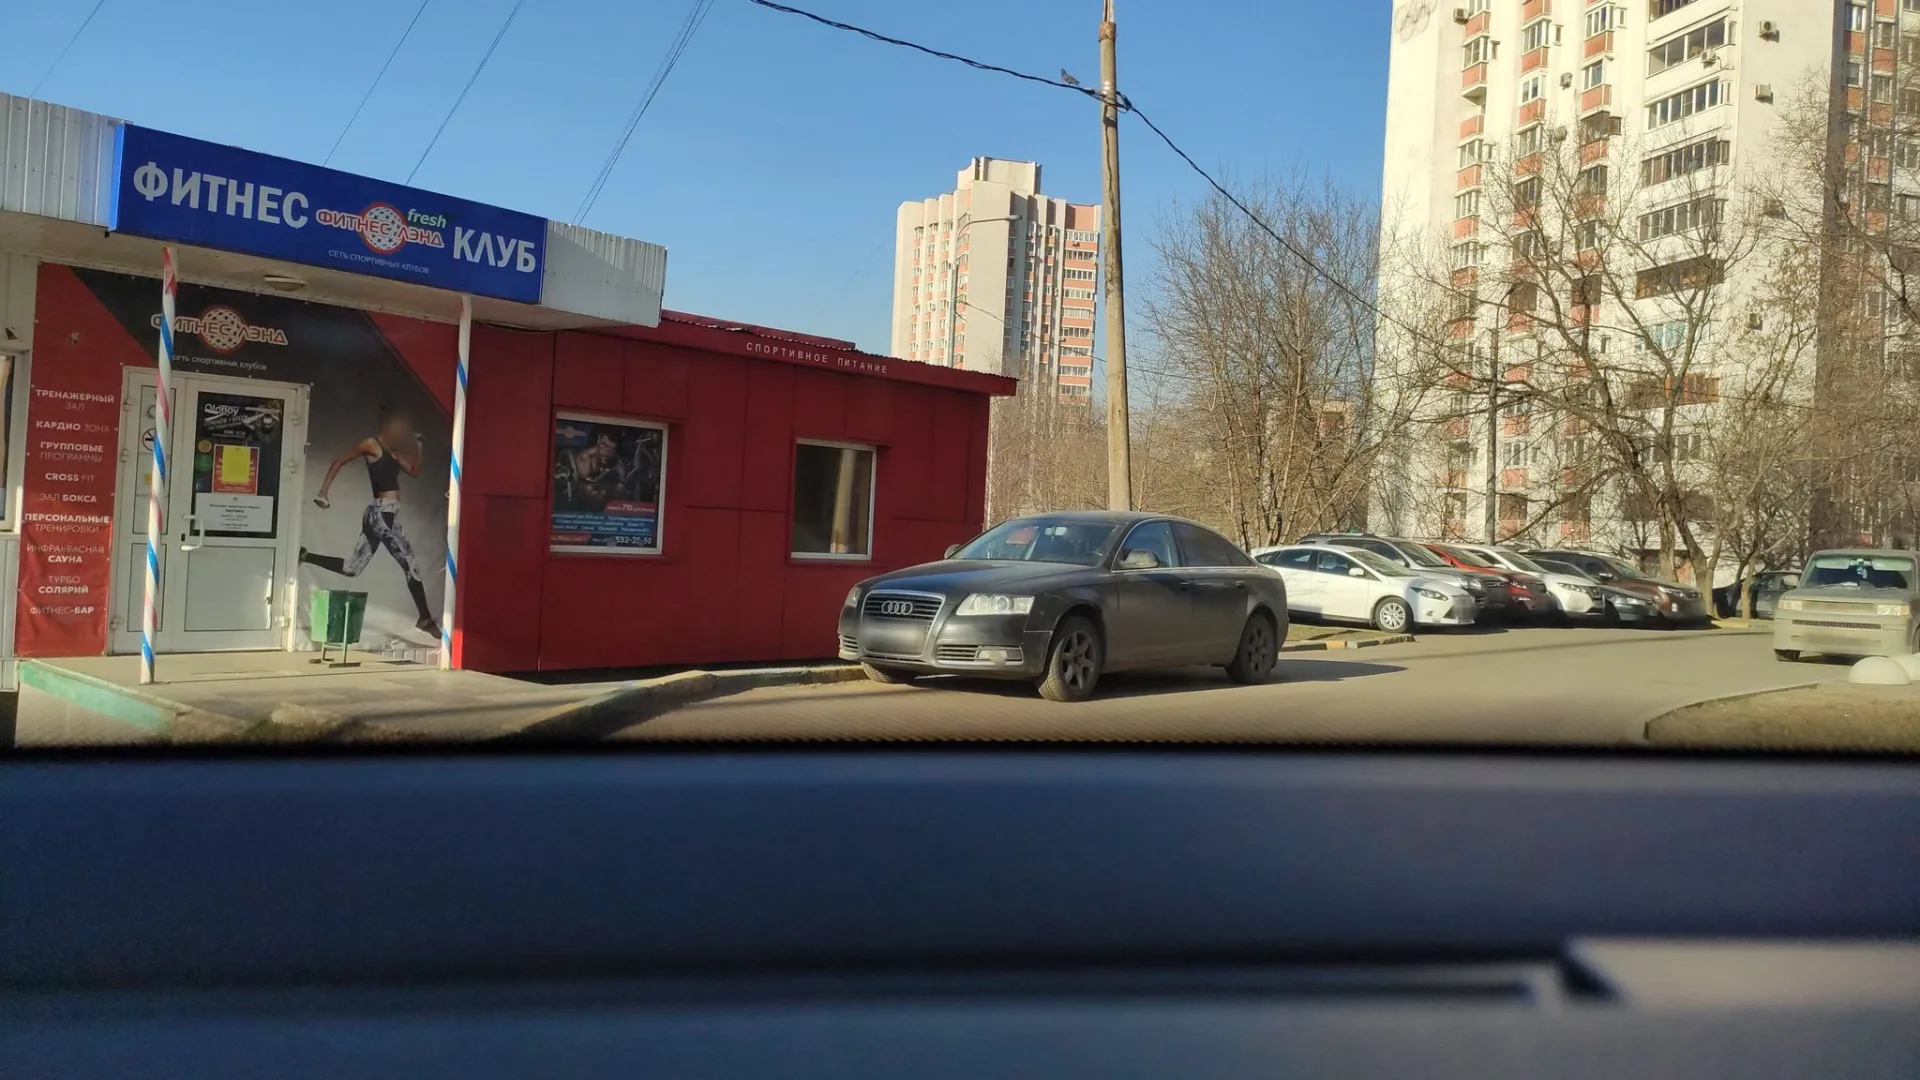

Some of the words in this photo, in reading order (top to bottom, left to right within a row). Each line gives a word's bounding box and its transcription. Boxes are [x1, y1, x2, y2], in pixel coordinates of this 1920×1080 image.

[133, 161, 309, 229] ФИТНЕС
[407, 208, 447, 229] fresh
[315, 208, 391, 237] ФИТНЕС
[396, 225, 445, 249] ЛЭНД
[453, 226, 537, 273] КЛУБ
[328, 249, 348, 260] СЕТЬ
[350, 252, 401, 269] СПОРТИВНЫХ
[401, 263, 430, 275] КЛУБОВ
[239, 324, 289, 346] ЛЭНД
[191, 356, 238, 368] спортивных
[239, 361, 267, 371] клубов
[746, 341, 828, 363] СПОРТИВНОЕ
[837, 357, 888, 374] ПИТАНИЕ
[35, 389, 115, 403] ТРЕНАЖЕРНЫЙ
[65, 402, 85, 411] ЗАЛ
[36, 420, 81, 431] КАРДИО
[83, 424, 110, 433] ЗОНА
[40, 441, 104, 453] ГРУППОВЫЕ
[40, 451, 103, 463] ПРОГРАММЫ
[45, 472, 79, 482] CROSS
[39, 493, 60, 501] ЗАЛ
[62, 494, 97, 503] БОКСА
[24, 513, 110, 524] ПЕРСОНАЛЬНЫЕ
[34, 524, 100, 533] ТРЕНИРОВКИ
[26, 544, 105, 554] ИНФРАКРАСНАЯ
[48, 555, 83, 563] САУНА
[48, 576, 81, 584] ТУРБО
[38, 585, 89, 594] СОЛЯРИЙ
[29, 606, 95, 615] ФИТНЕС-БАР
